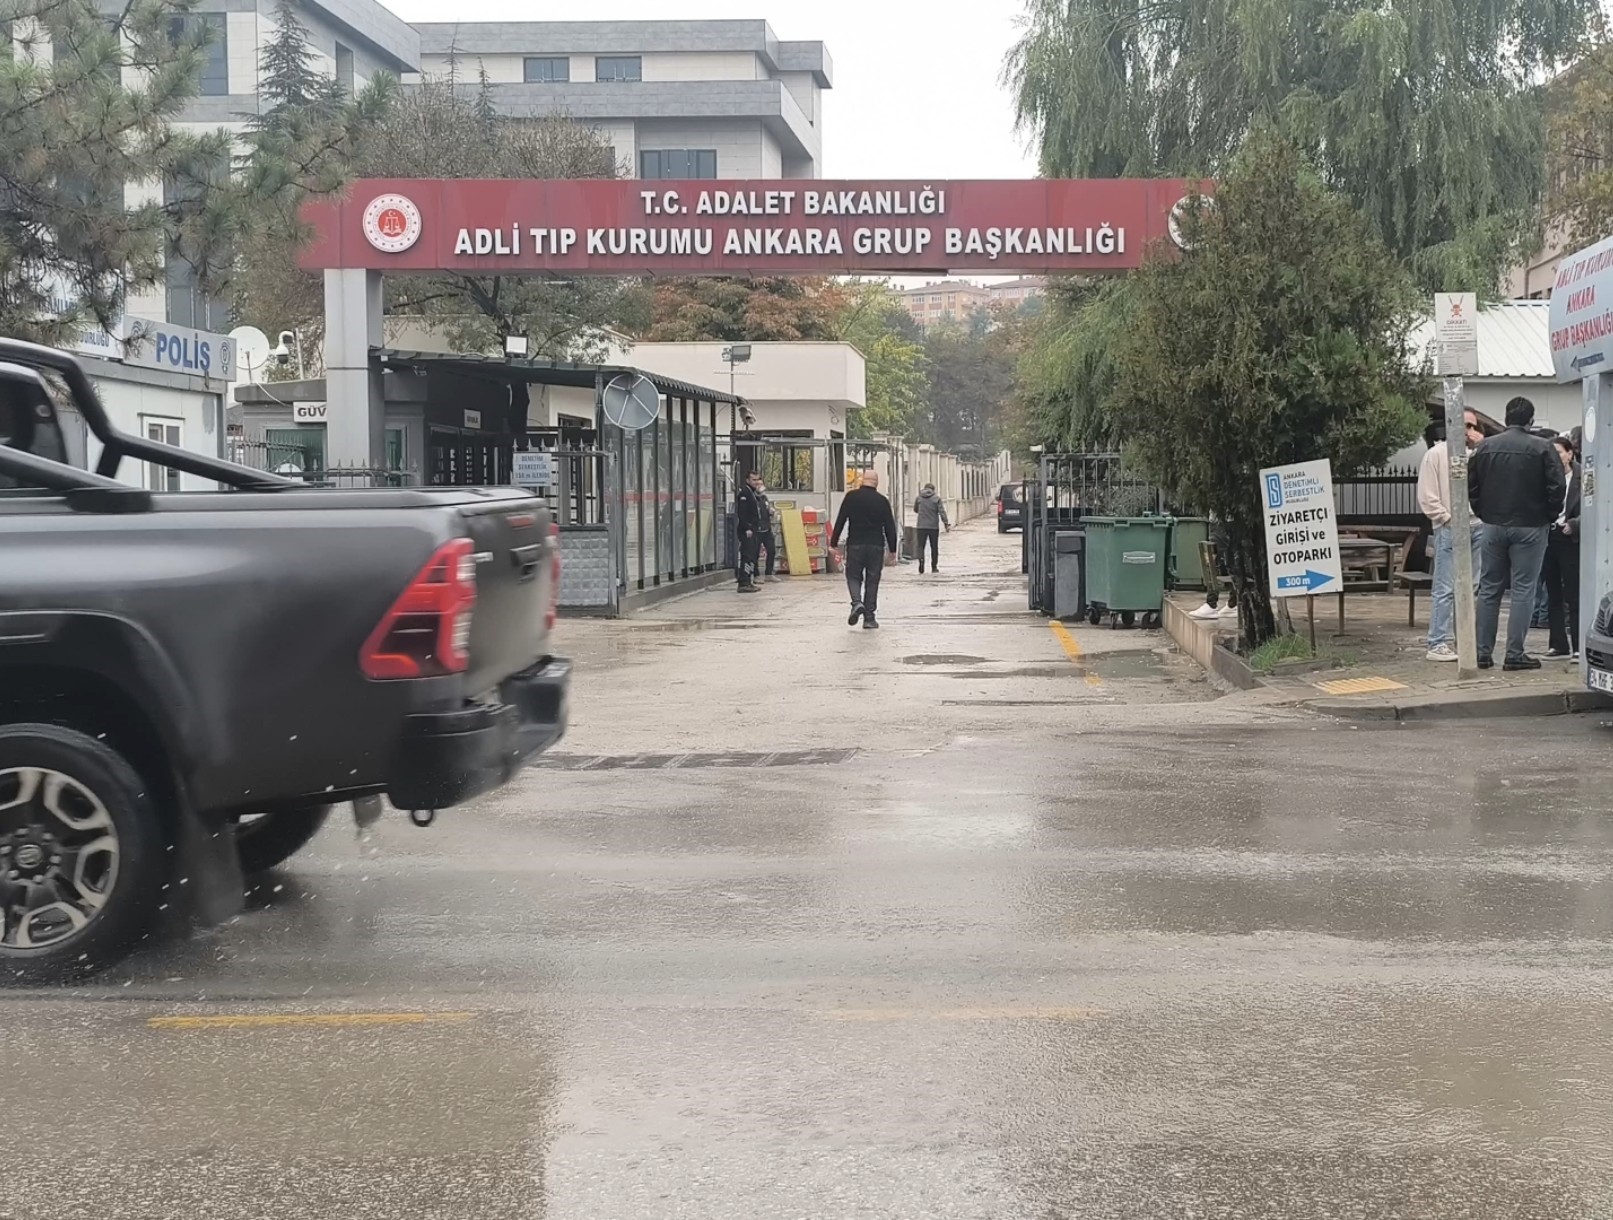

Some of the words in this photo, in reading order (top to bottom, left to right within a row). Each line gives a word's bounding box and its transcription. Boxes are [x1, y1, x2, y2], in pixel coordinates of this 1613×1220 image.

[641, 191, 687, 214] T.C.
[696, 191, 796, 215] ADALET
[804, 186, 945, 214] BAKANLIĞI
[454, 222, 520, 255] ADLİ
[530, 228, 577, 255] TIP
[587, 228, 713, 255] KURUMU
[723, 228, 844, 255] ANKARA
[853, 227, 932, 255] GRUP
[945, 222, 1125, 260] BAŞKANLIĞI
[1566, 285, 1595, 315] ANKARA
[1551, 327, 1569, 351] GRUP
[156, 332, 211, 371] POLİS
[1283, 471, 1306, 480] ANKARA
[1283, 477, 1319, 489] DENETİMLİ
[1284, 486, 1325, 499] SERBESTLİK
[1276, 527, 1310, 545] GİRİŞİ
[1311, 530, 1326, 541] ve
[1273, 547, 1332, 565] OTOPARKI
[1285, 577, 1301, 586] 300
[1302, 577, 1311, 586] m
